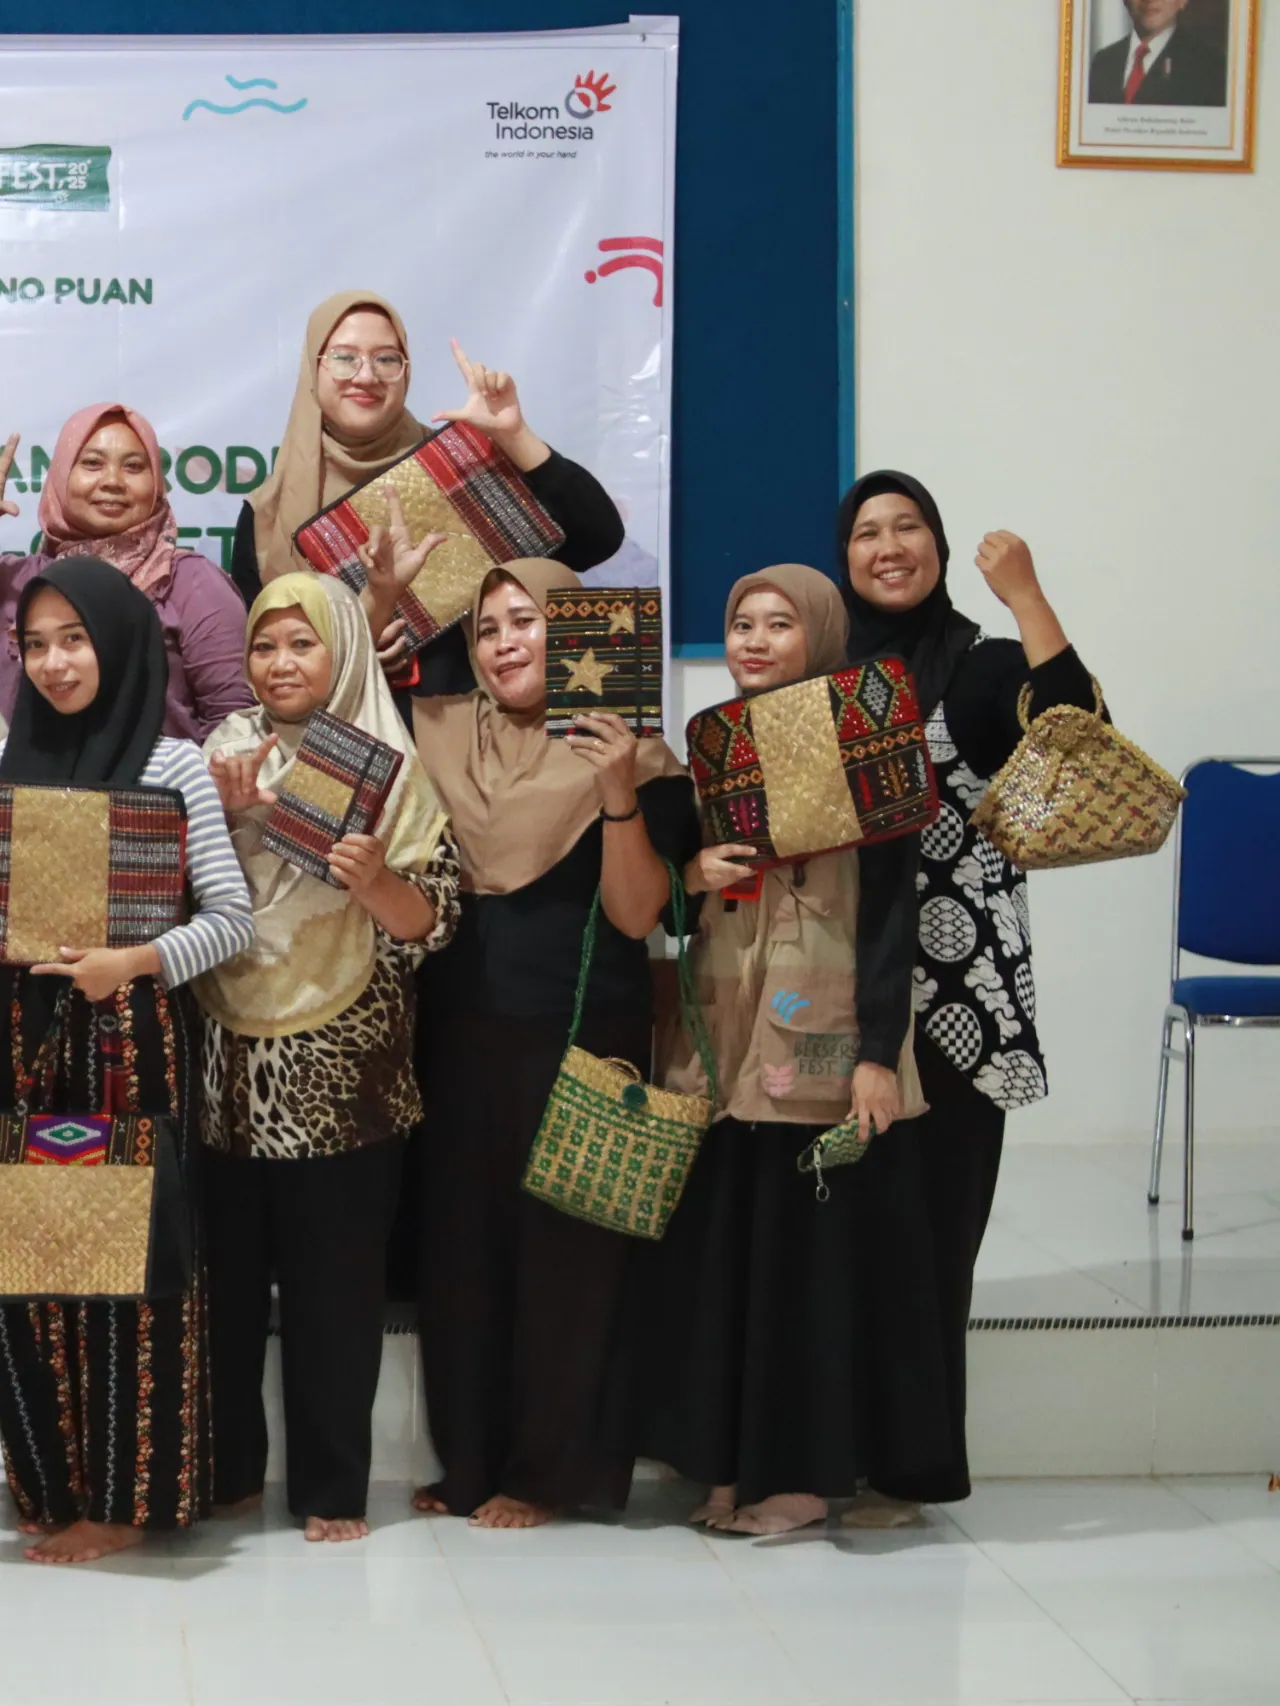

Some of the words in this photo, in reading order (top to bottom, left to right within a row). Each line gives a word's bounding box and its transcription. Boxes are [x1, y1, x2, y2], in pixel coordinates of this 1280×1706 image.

[486, 102, 560, 120] Telkom
[496, 121, 595, 140] Indonesia
[485, 150, 499, 158] the
[501, 150, 525, 158] world
[527, 150, 534, 158] in
[536, 151, 555, 160] your
[556, 150, 577, 158] hand
[54, 276, 153, 306] PUAN
